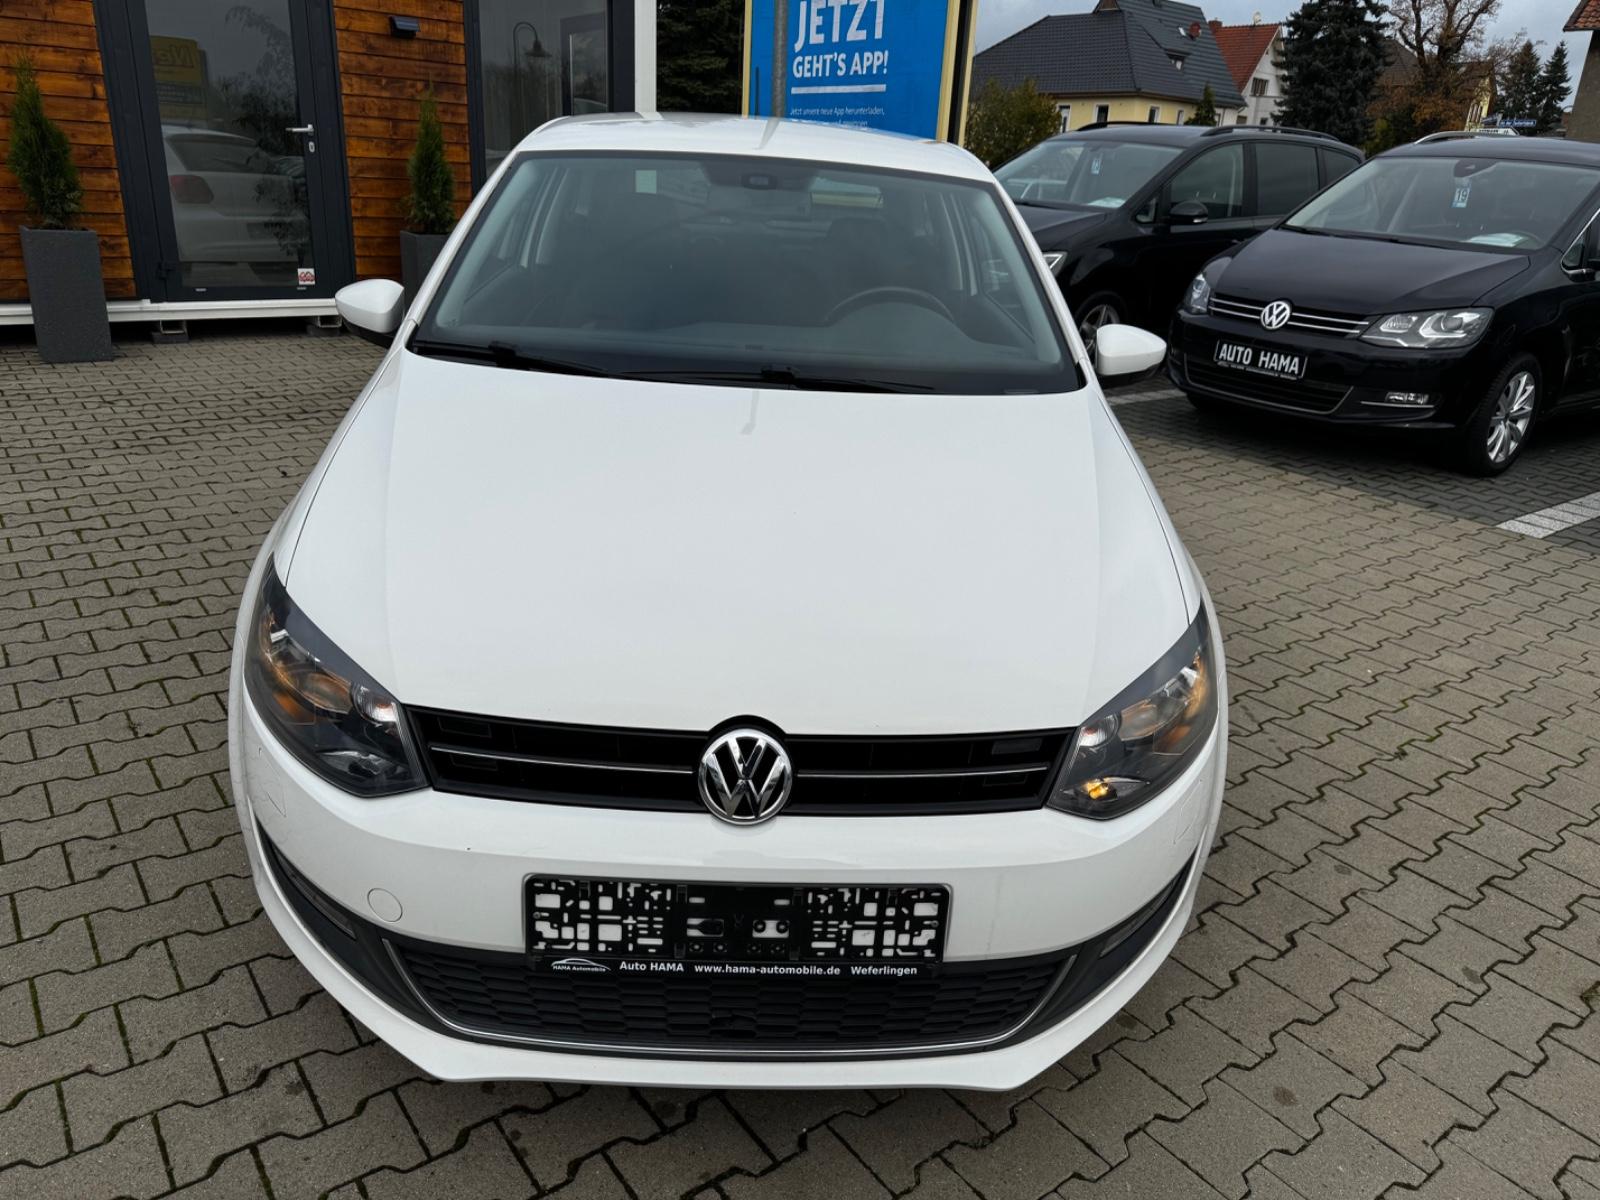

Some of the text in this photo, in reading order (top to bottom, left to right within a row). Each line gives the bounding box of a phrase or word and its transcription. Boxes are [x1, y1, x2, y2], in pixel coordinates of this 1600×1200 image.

[794, 0, 886, 53] JETZT
[792, 50, 889, 79] GEHT'S APP!
[1218, 344, 1253, 365] AUTO
[1258, 350, 1300, 375] HAMA
[619, 960, 918, 977] Auto HAMA www.hama-automobile.de Weferlingen
